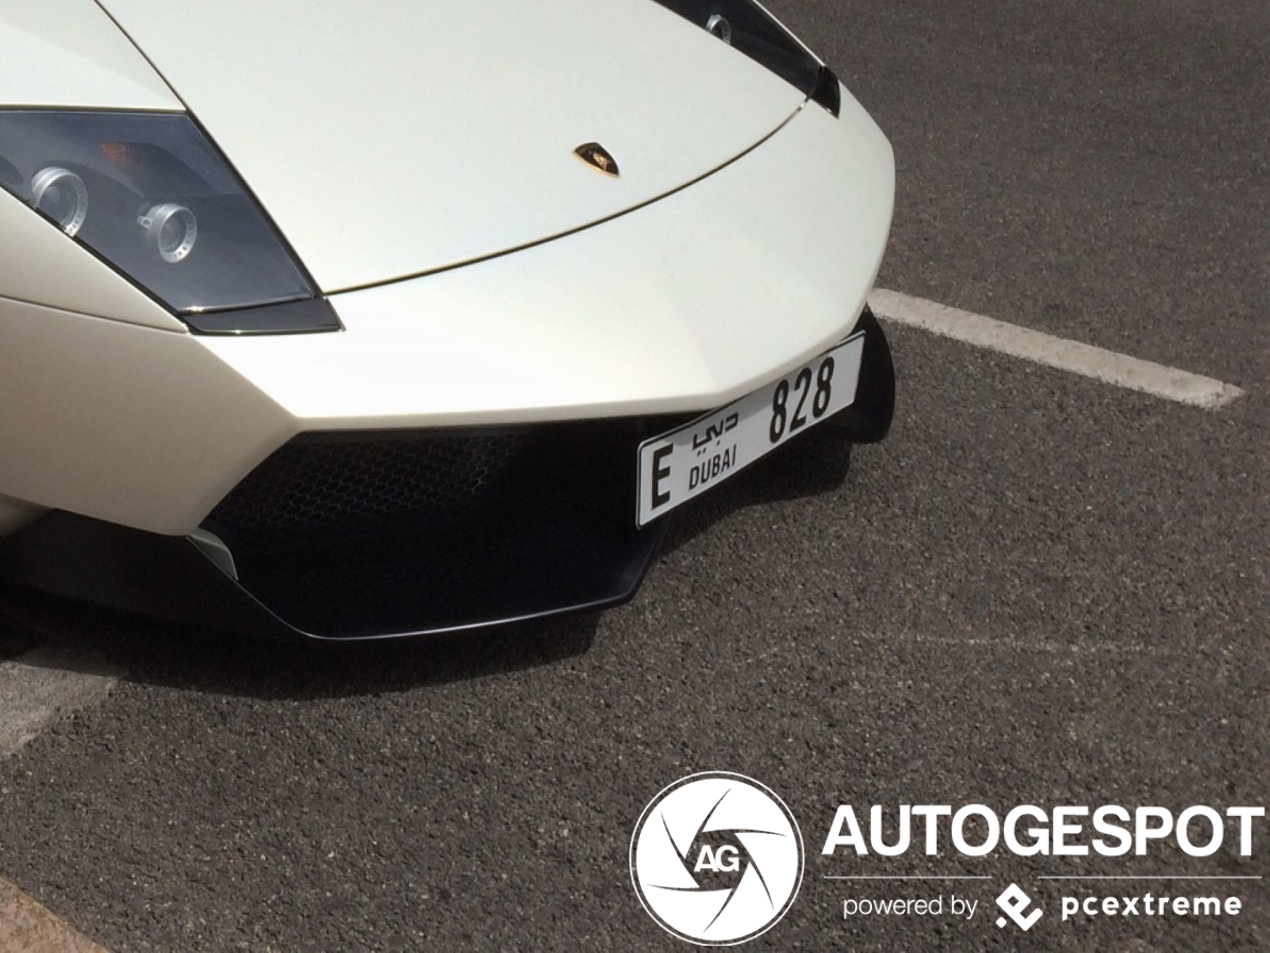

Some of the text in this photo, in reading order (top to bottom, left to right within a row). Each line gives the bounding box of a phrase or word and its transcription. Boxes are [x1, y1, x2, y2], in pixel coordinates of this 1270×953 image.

[651, 356, 835, 510] E 828
[692, 412, 740, 457] دبي
[688, 444, 737, 491] DUBAI
